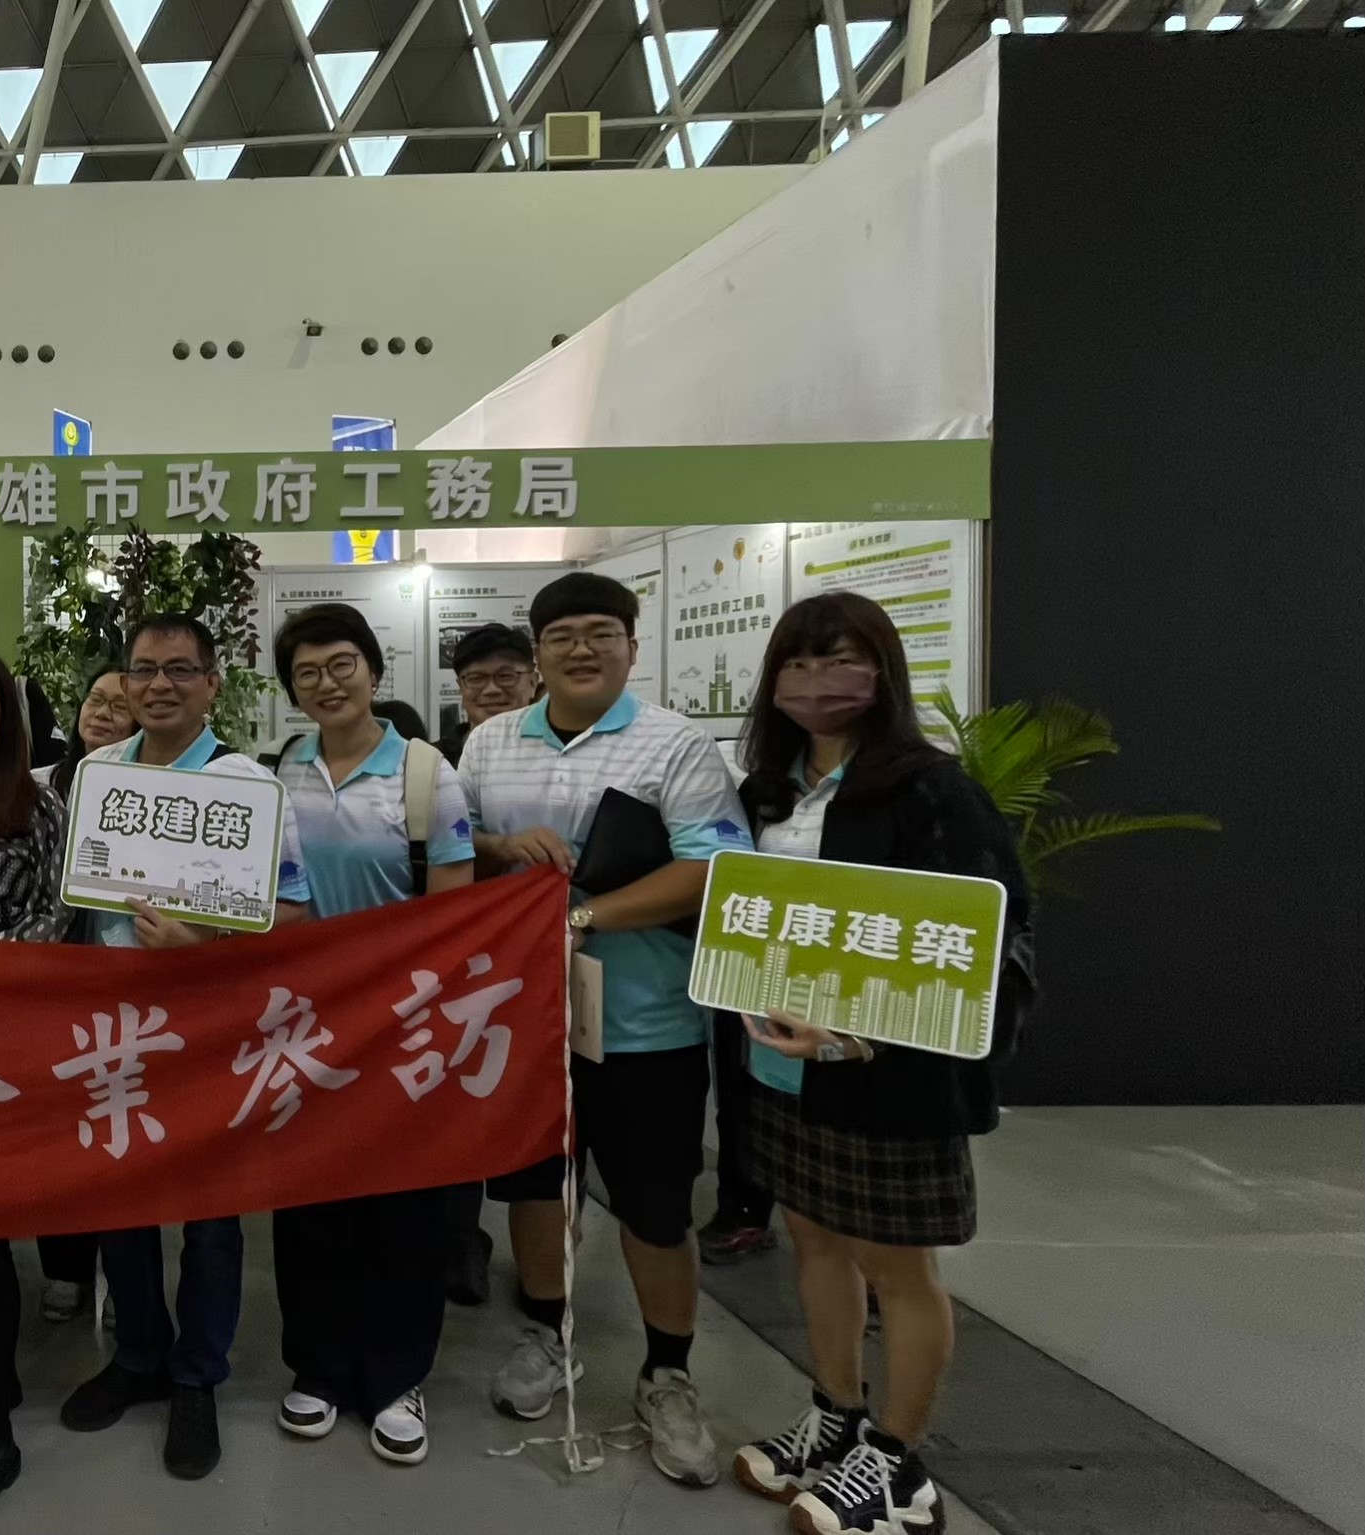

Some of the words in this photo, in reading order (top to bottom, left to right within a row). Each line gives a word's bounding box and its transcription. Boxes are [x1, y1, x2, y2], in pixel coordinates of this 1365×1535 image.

[99, 788, 252, 850] 綠建築
[721, 892, 977, 972] 健康建築
